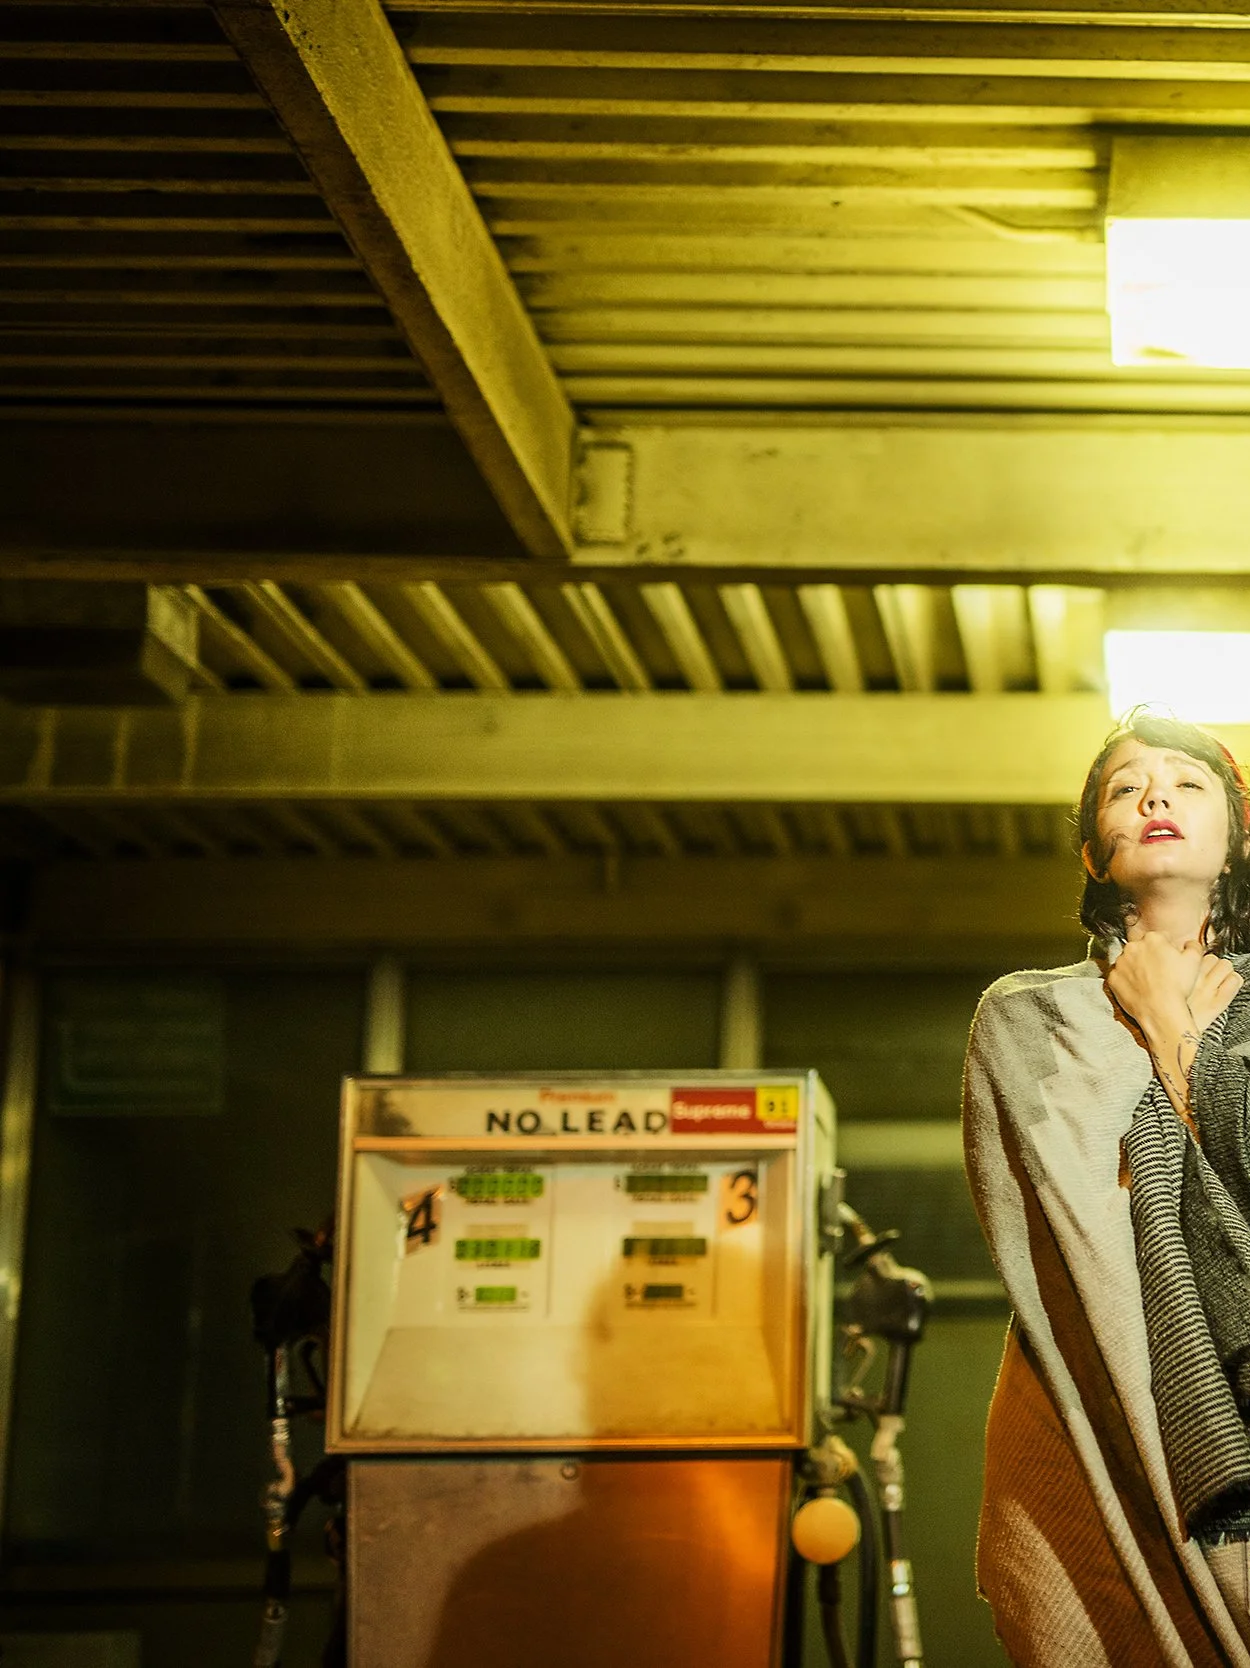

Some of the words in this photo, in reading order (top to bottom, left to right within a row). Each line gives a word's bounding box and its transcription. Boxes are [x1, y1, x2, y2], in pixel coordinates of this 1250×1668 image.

[486, 1109, 542, 1134] NO
[560, 1109, 668, 1134] LEAD
[672, 1101, 751, 1120] Supreme
[406, 1188, 440, 1244] 4
[726, 1171, 757, 1224] 3
